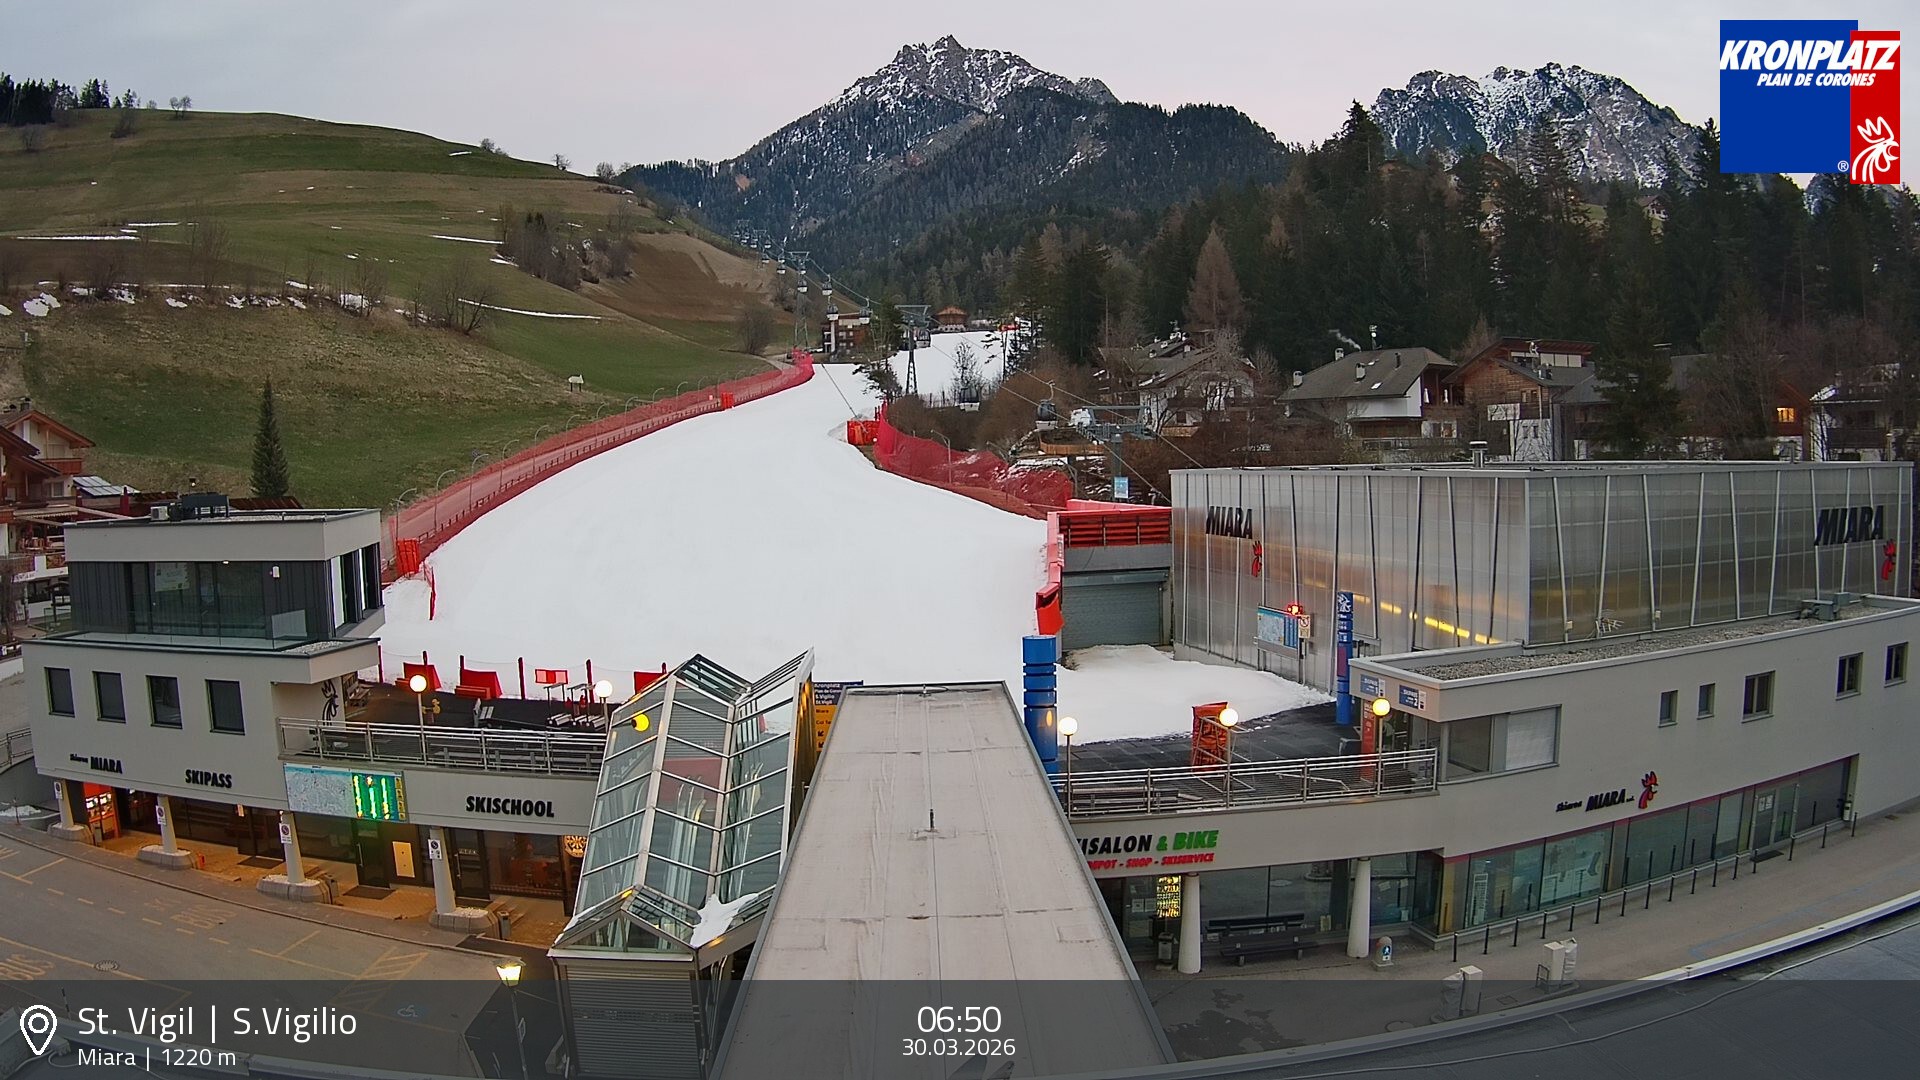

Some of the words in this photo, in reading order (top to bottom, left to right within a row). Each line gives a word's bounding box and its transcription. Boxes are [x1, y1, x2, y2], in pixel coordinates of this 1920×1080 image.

[1206, 506, 1252, 539] MIARA
[1814, 505, 1884, 546] MIARA
[90, 756, 123, 774] MIARA
[185, 769, 232, 788] SKIPASS
[466, 795, 555, 818] SKISCHOOL
[1585, 789, 1626, 812] MIARA
[1156, 836, 1167, 851] &
[1173, 830, 1219, 850] BIKE
[1126, 857, 1152, 868] SHOP
[1161, 853, 1215, 865] SKISERVICE
